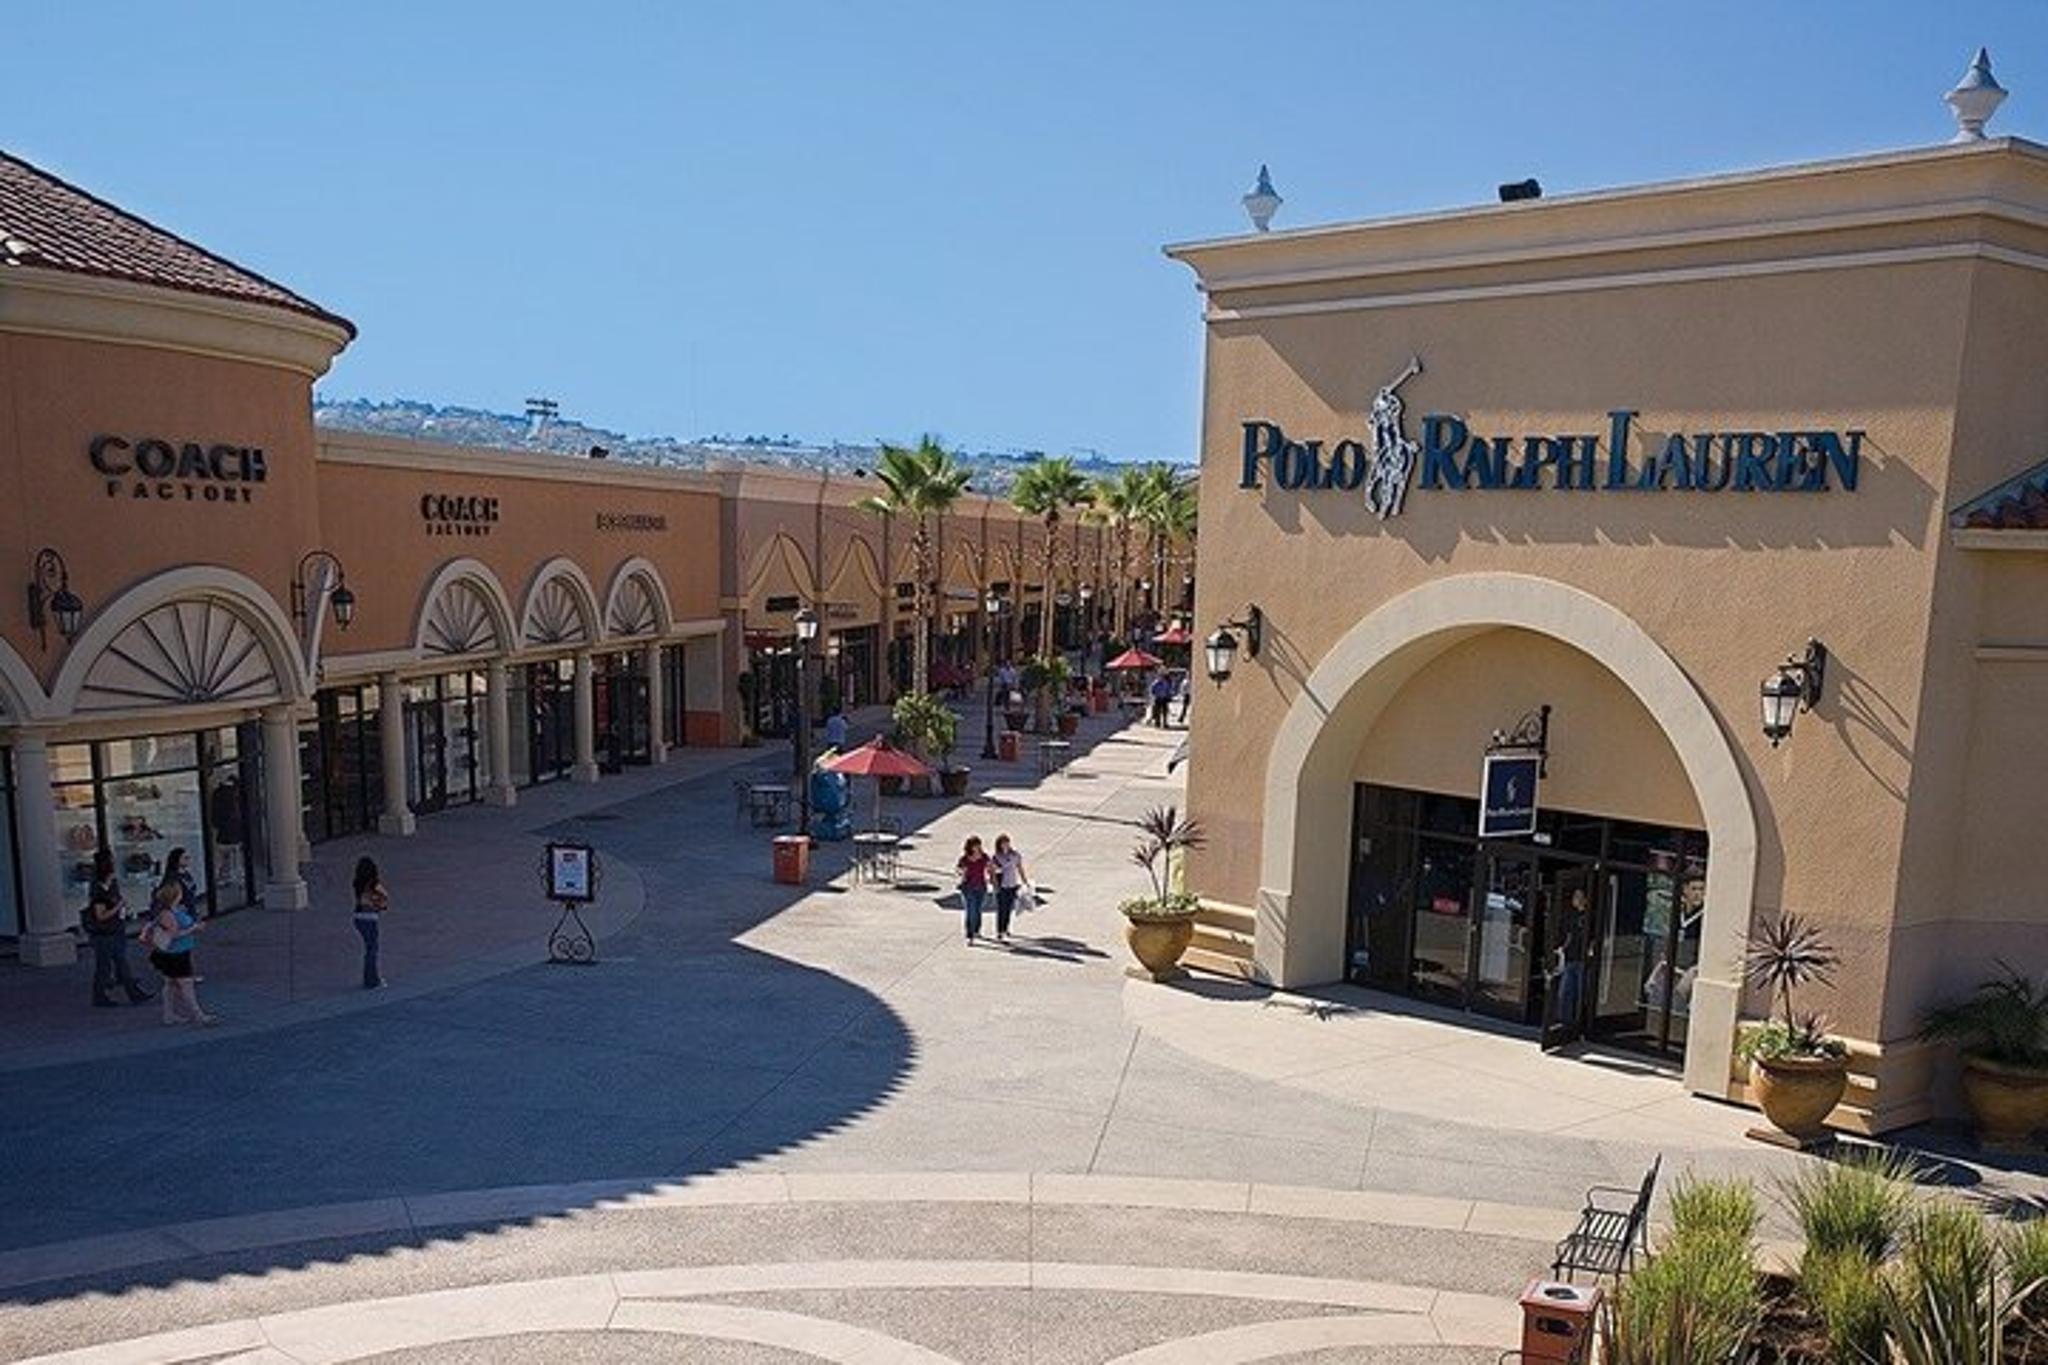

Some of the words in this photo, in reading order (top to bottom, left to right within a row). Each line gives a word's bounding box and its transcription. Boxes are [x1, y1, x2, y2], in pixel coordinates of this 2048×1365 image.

[90, 434, 266, 482] COACH
[1241, 421, 1366, 490] POLO
[1420, 415, 1597, 490] RALPH
[1604, 411, 1866, 491] LAUREN
[106, 482, 253, 503] FACTORY
[421, 494, 498, 522] COACH
[426, 523, 491, 536] FACTORY
